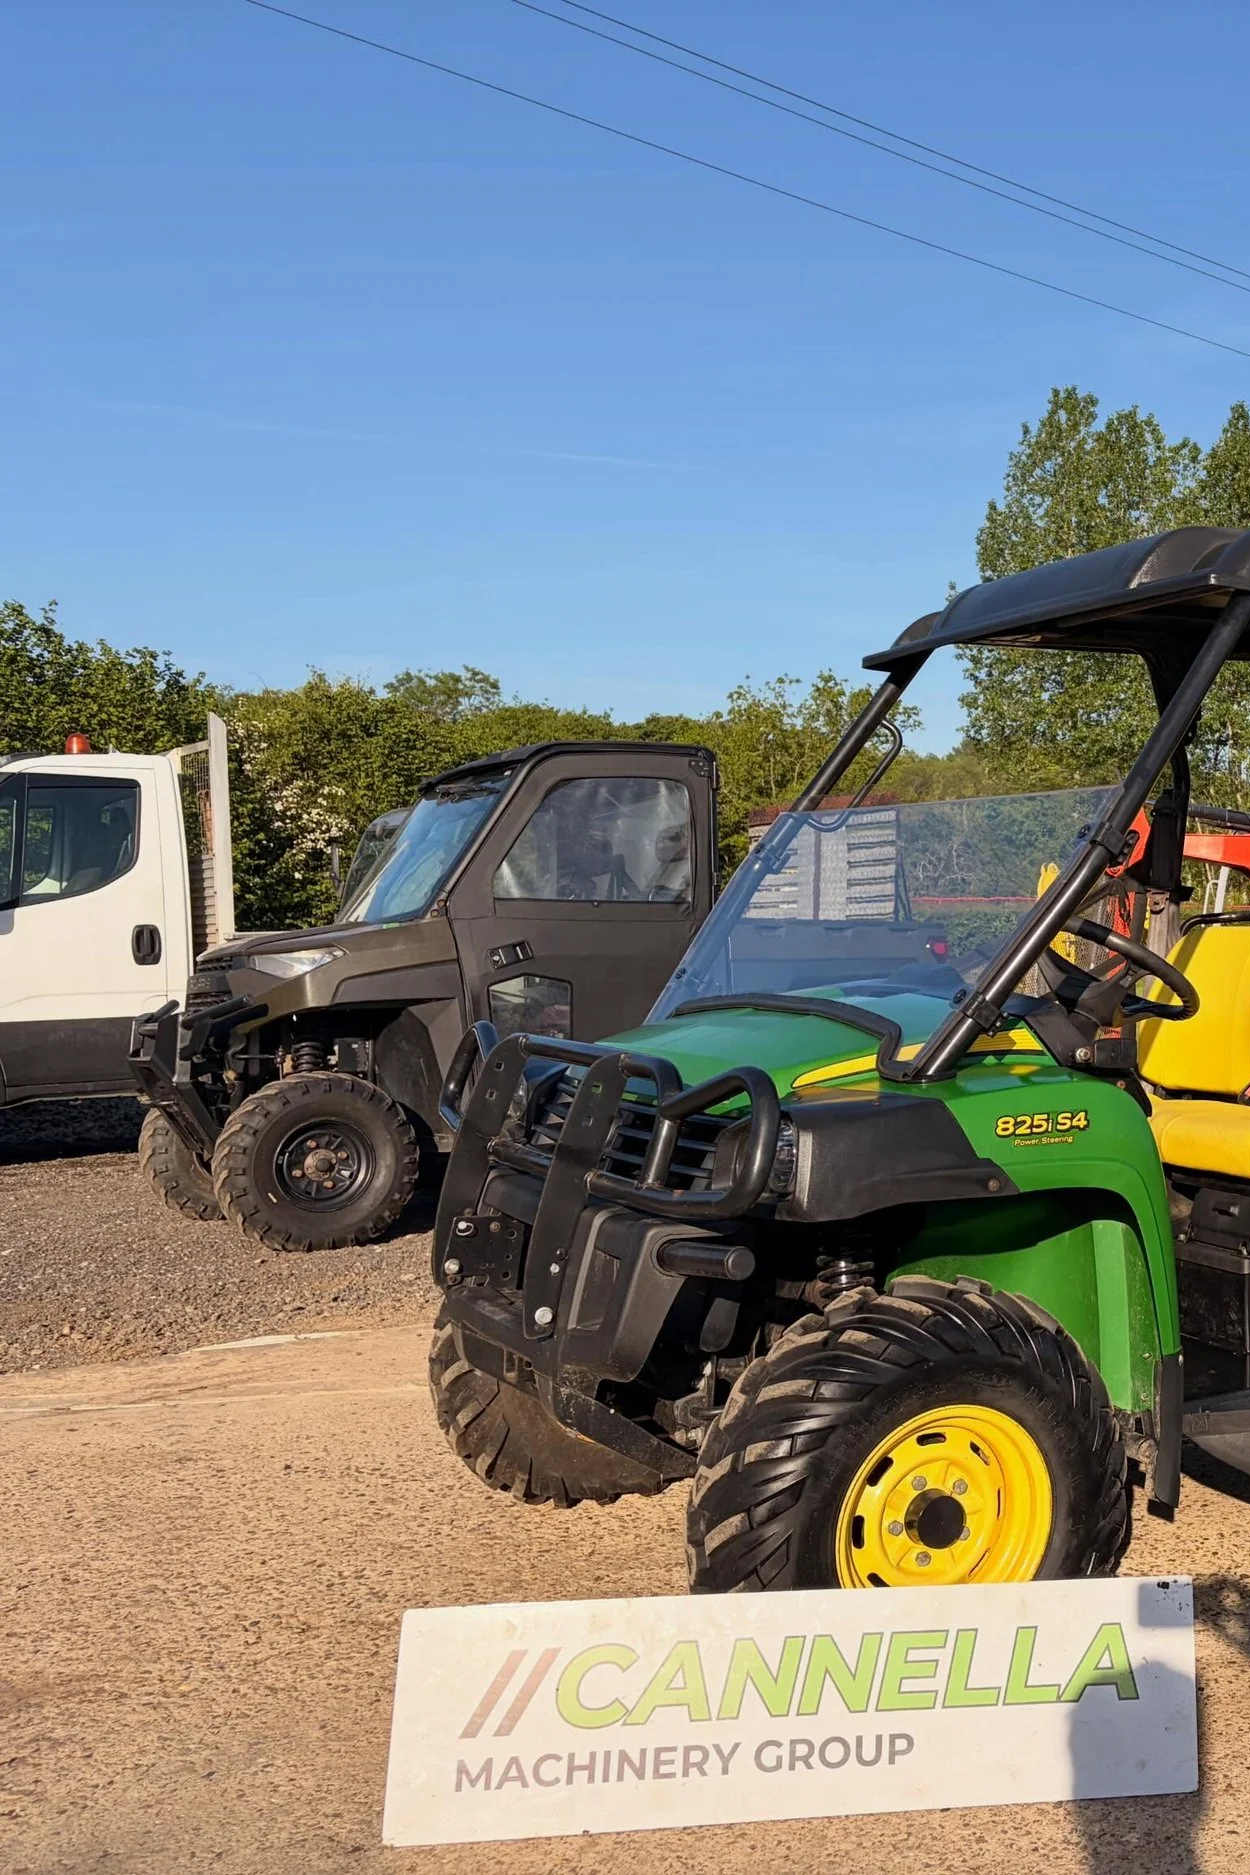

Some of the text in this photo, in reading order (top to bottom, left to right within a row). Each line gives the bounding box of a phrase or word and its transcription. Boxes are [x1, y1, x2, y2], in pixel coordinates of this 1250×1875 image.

[995, 1111, 1088, 1136] 825i S4
[1014, 1135, 1074, 1147] Power Steering
[454, 1733, 915, 1793] MACHINERY GROUP
